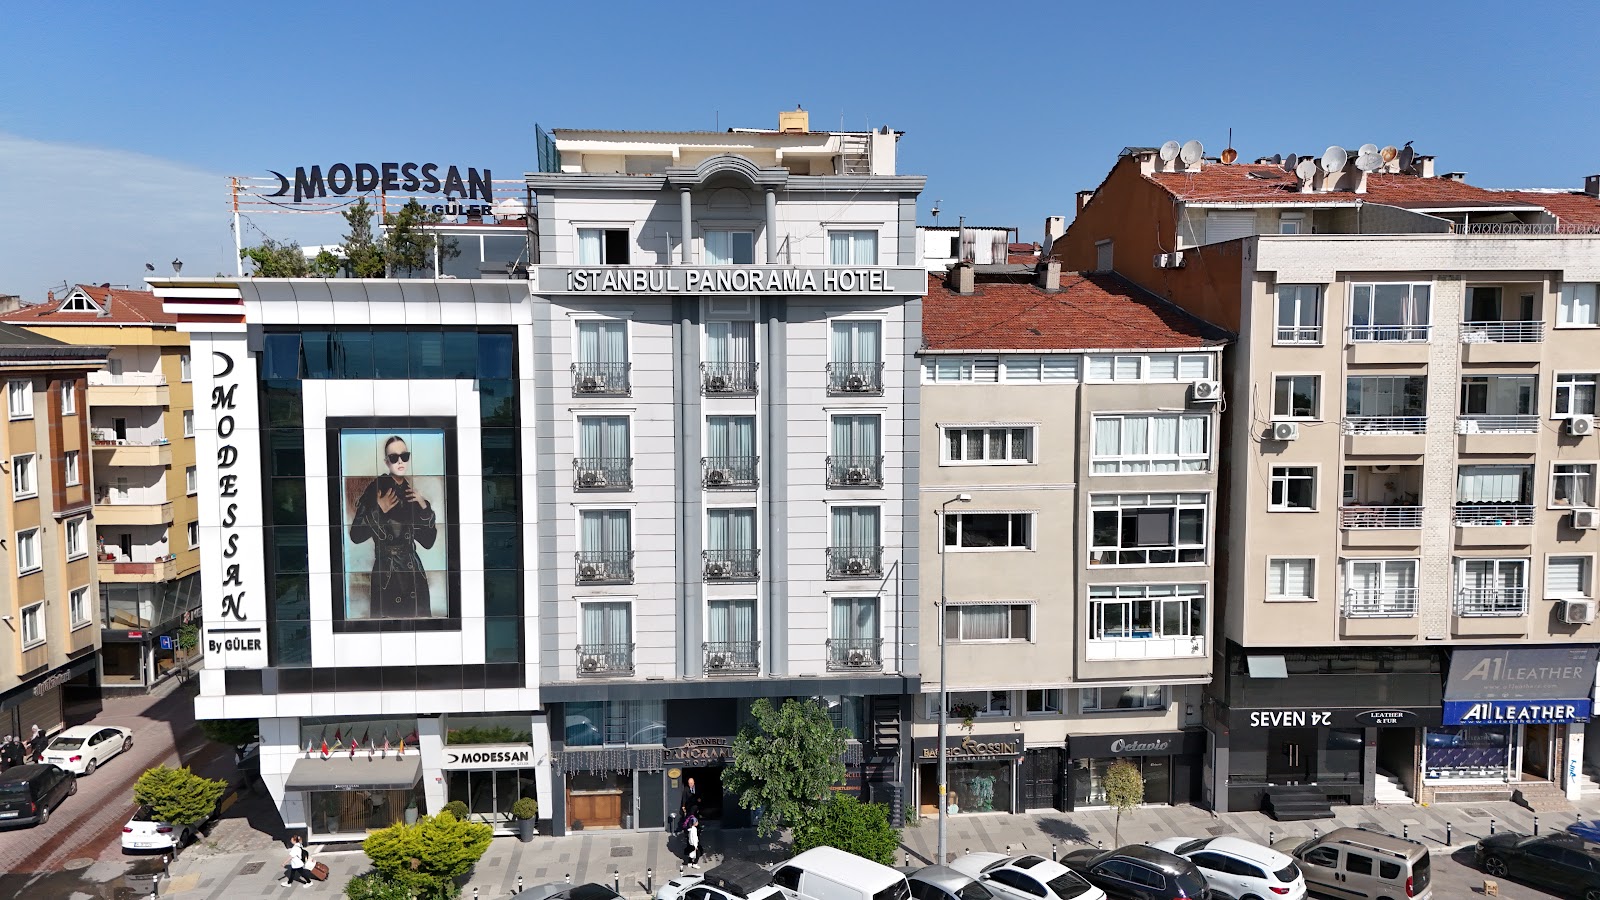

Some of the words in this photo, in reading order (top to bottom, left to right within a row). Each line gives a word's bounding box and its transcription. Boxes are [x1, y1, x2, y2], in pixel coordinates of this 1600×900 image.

[294, 162, 493, 203] MODESSAN
[566, 269, 681, 293] İSTANBUL
[685, 269, 818, 293] PANORAMA
[823, 269, 896, 292] HOTEL
[211, 382, 247, 622] MODESSAN
[208, 639, 223, 653] By
[225, 636, 262, 652] GÜLER
[1461, 657, 1503, 681] A1
[1507, 666, 1583, 680] LEATHER
[1250, 711, 1306, 727] SEVEN
[1311, 711, 1332, 726] 24
[1463, 703, 1488, 720] A1
[1495, 705, 1576, 720] LEATHER
[663, 747, 735, 760] PANORAM
[961, 735, 1016, 755] ROSSINI
[1110, 738, 1168, 753] Octavio
[461, 751, 529, 764] MODESSAN
